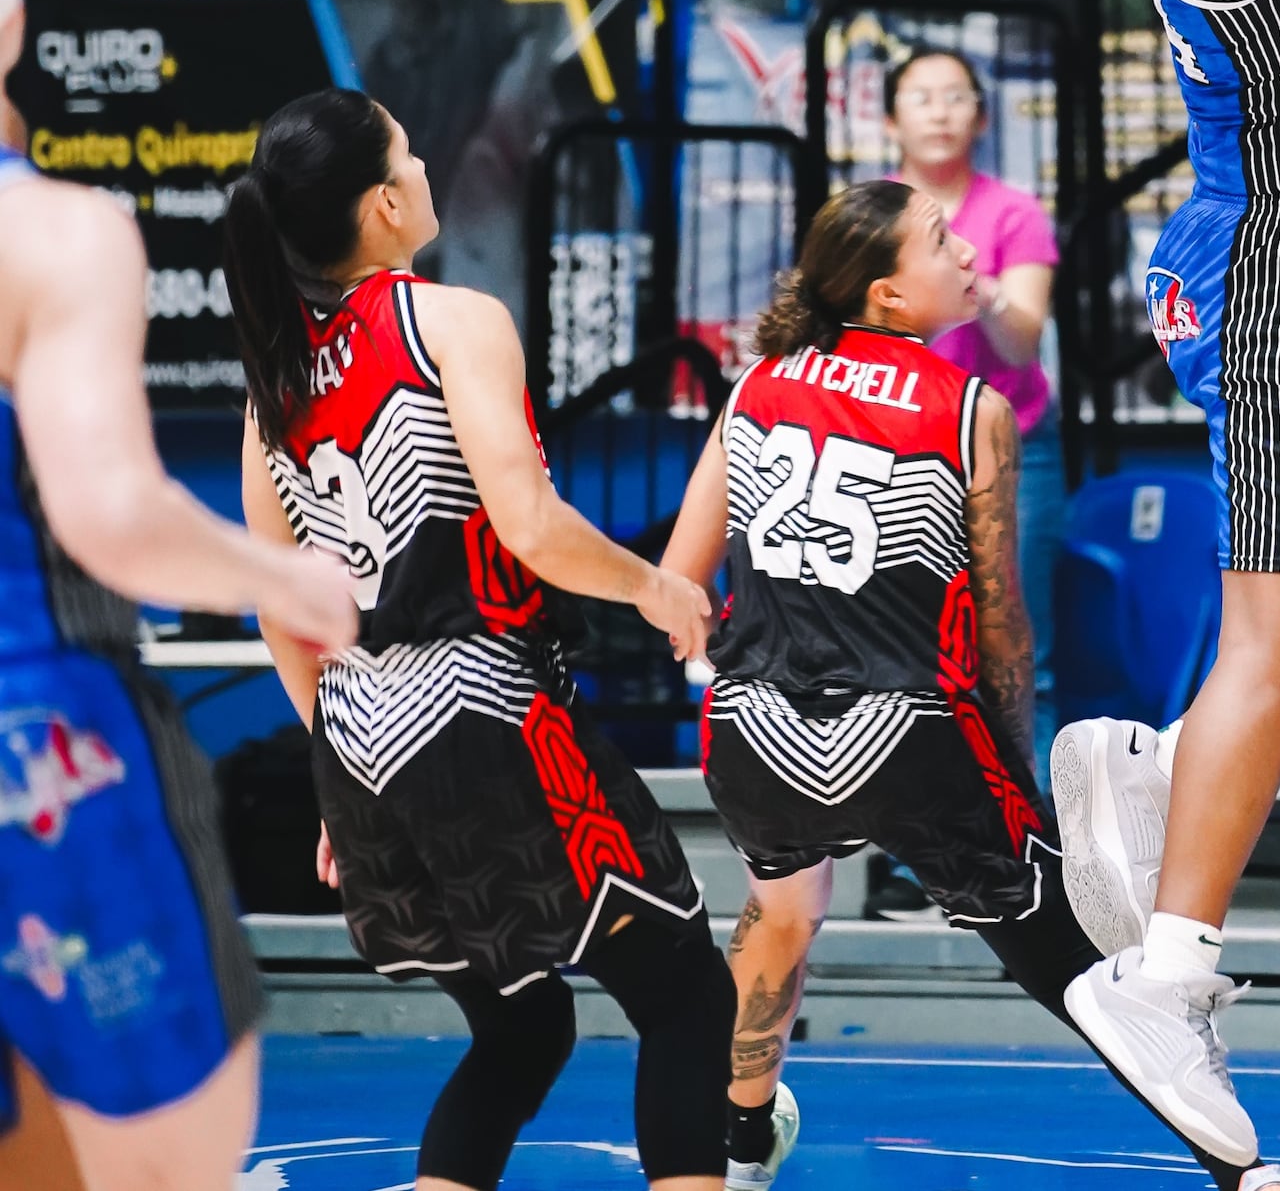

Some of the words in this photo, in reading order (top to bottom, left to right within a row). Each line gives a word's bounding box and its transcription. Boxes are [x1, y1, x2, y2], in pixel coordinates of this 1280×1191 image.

[32, 128, 131, 169] Centro
[771, 345, 922, 413] MITCHELL
[747, 423, 895, 595] 25
